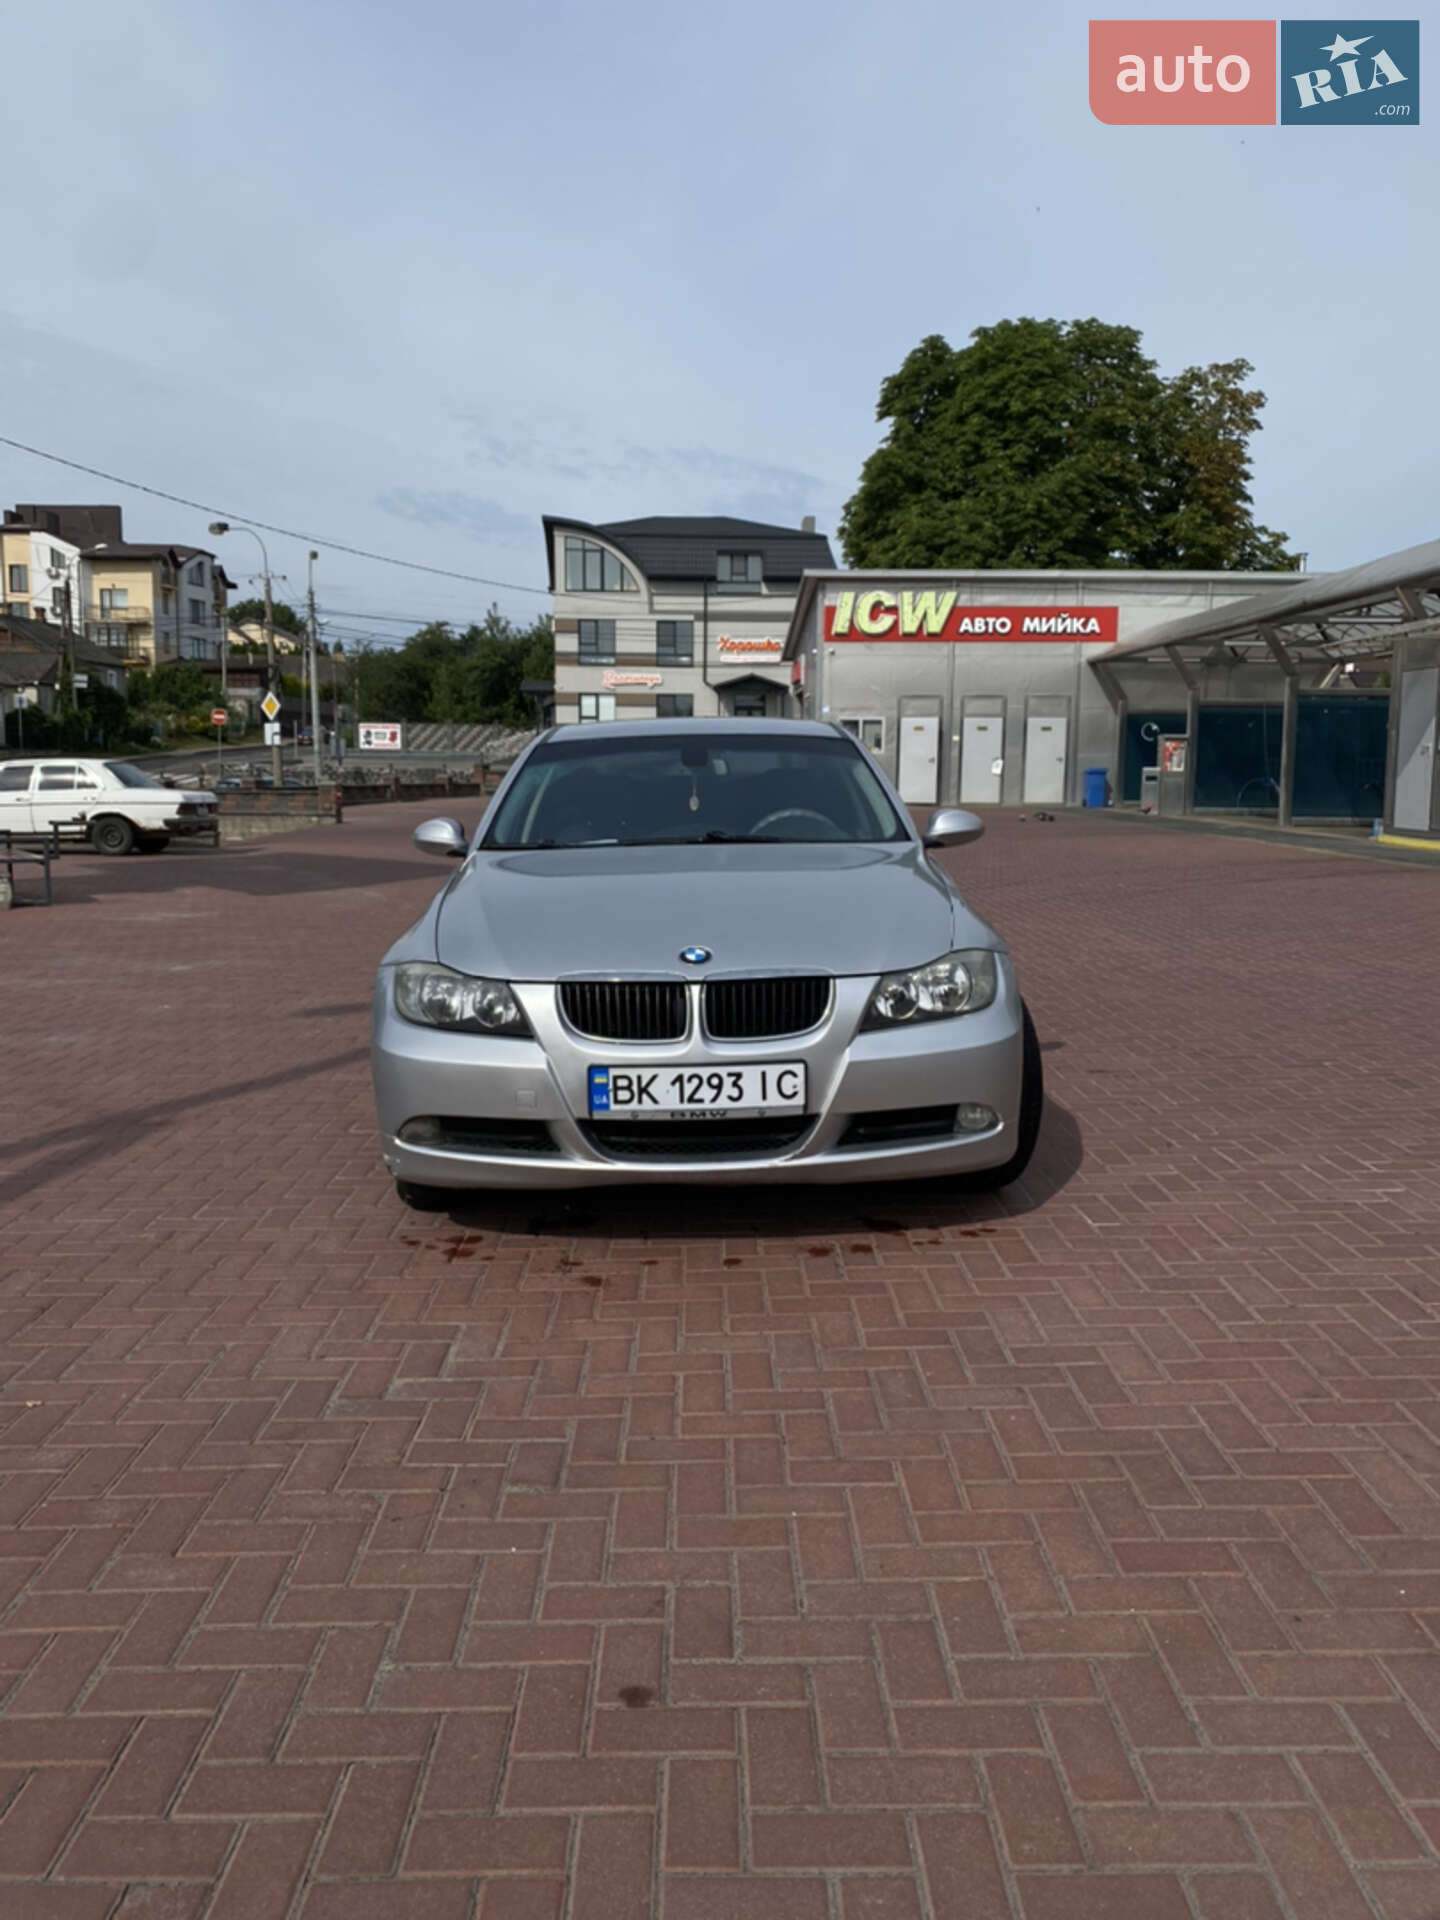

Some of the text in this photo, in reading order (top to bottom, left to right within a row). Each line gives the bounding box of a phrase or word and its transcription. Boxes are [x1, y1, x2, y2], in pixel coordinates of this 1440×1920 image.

[832, 590, 957, 636] ICW
[958, 613, 1101, 634] АВТО МИЙКА
[593, 1094, 608, 1104] UA
[612, 1069, 800, 1105] BK 1293 IC
